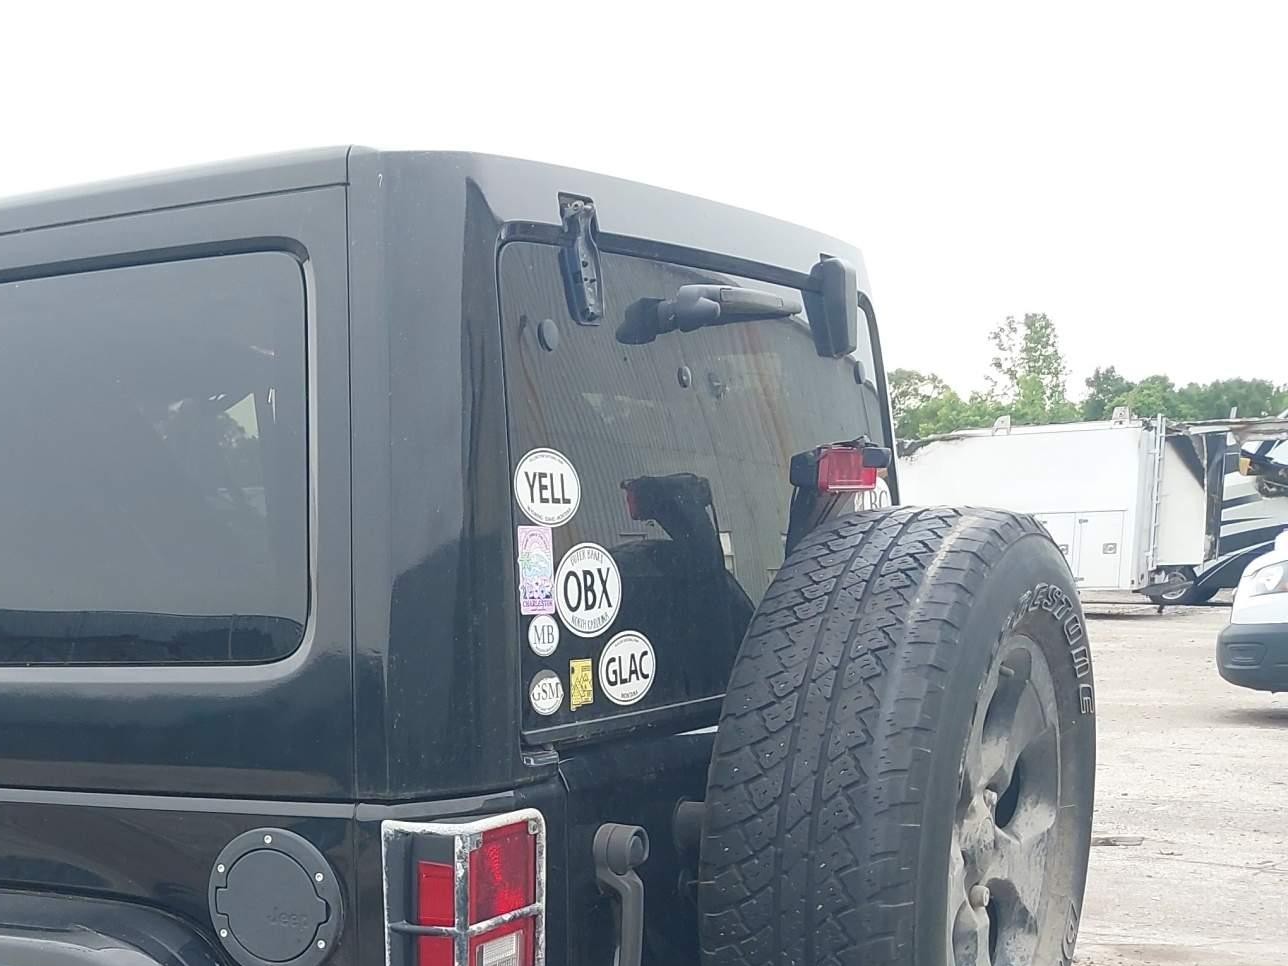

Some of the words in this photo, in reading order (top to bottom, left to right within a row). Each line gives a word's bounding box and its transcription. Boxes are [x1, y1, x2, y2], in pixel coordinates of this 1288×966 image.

[524, 471, 571, 504] YELL
[563, 567, 613, 613] OBX
[532, 624, 555, 645] MB
[605, 650, 650, 687] GLAC
